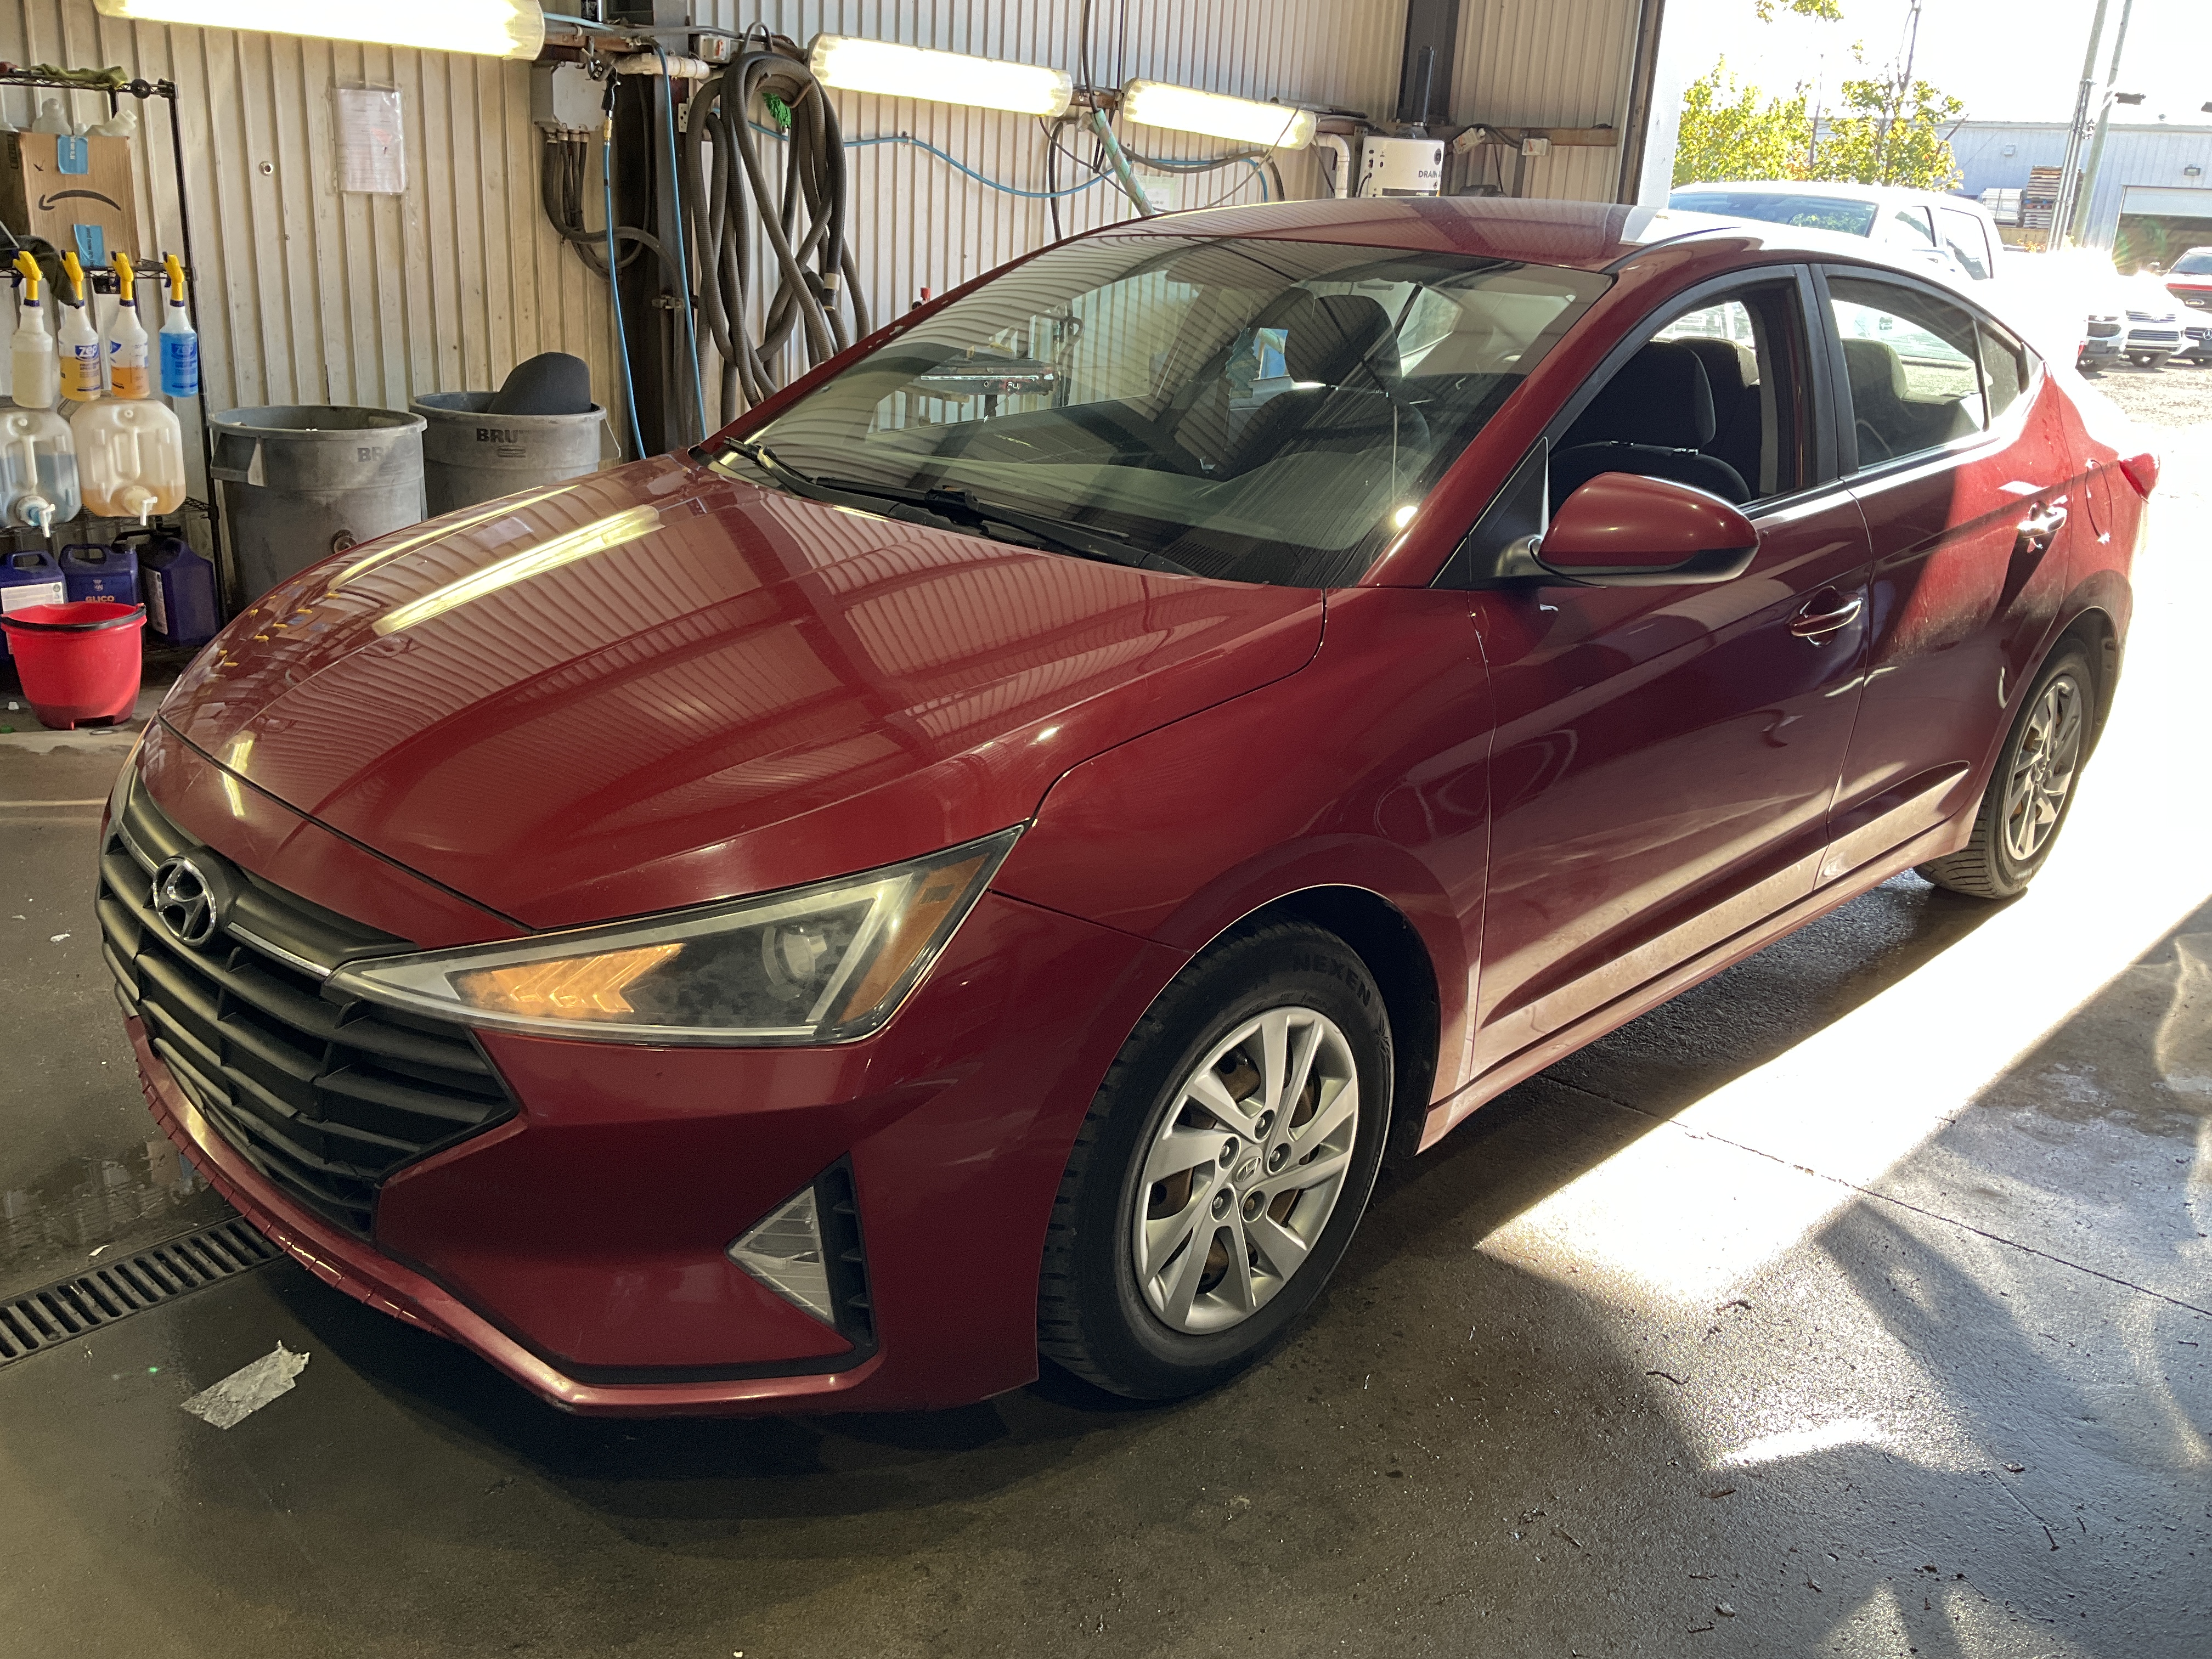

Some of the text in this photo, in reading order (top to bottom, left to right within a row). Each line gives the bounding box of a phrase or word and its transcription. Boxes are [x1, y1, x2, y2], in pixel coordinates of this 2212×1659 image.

[476, 428, 545, 443] BRUT
[85, 595, 115, 603] GLICO
[1293, 953, 1371, 1007] NEXEN
